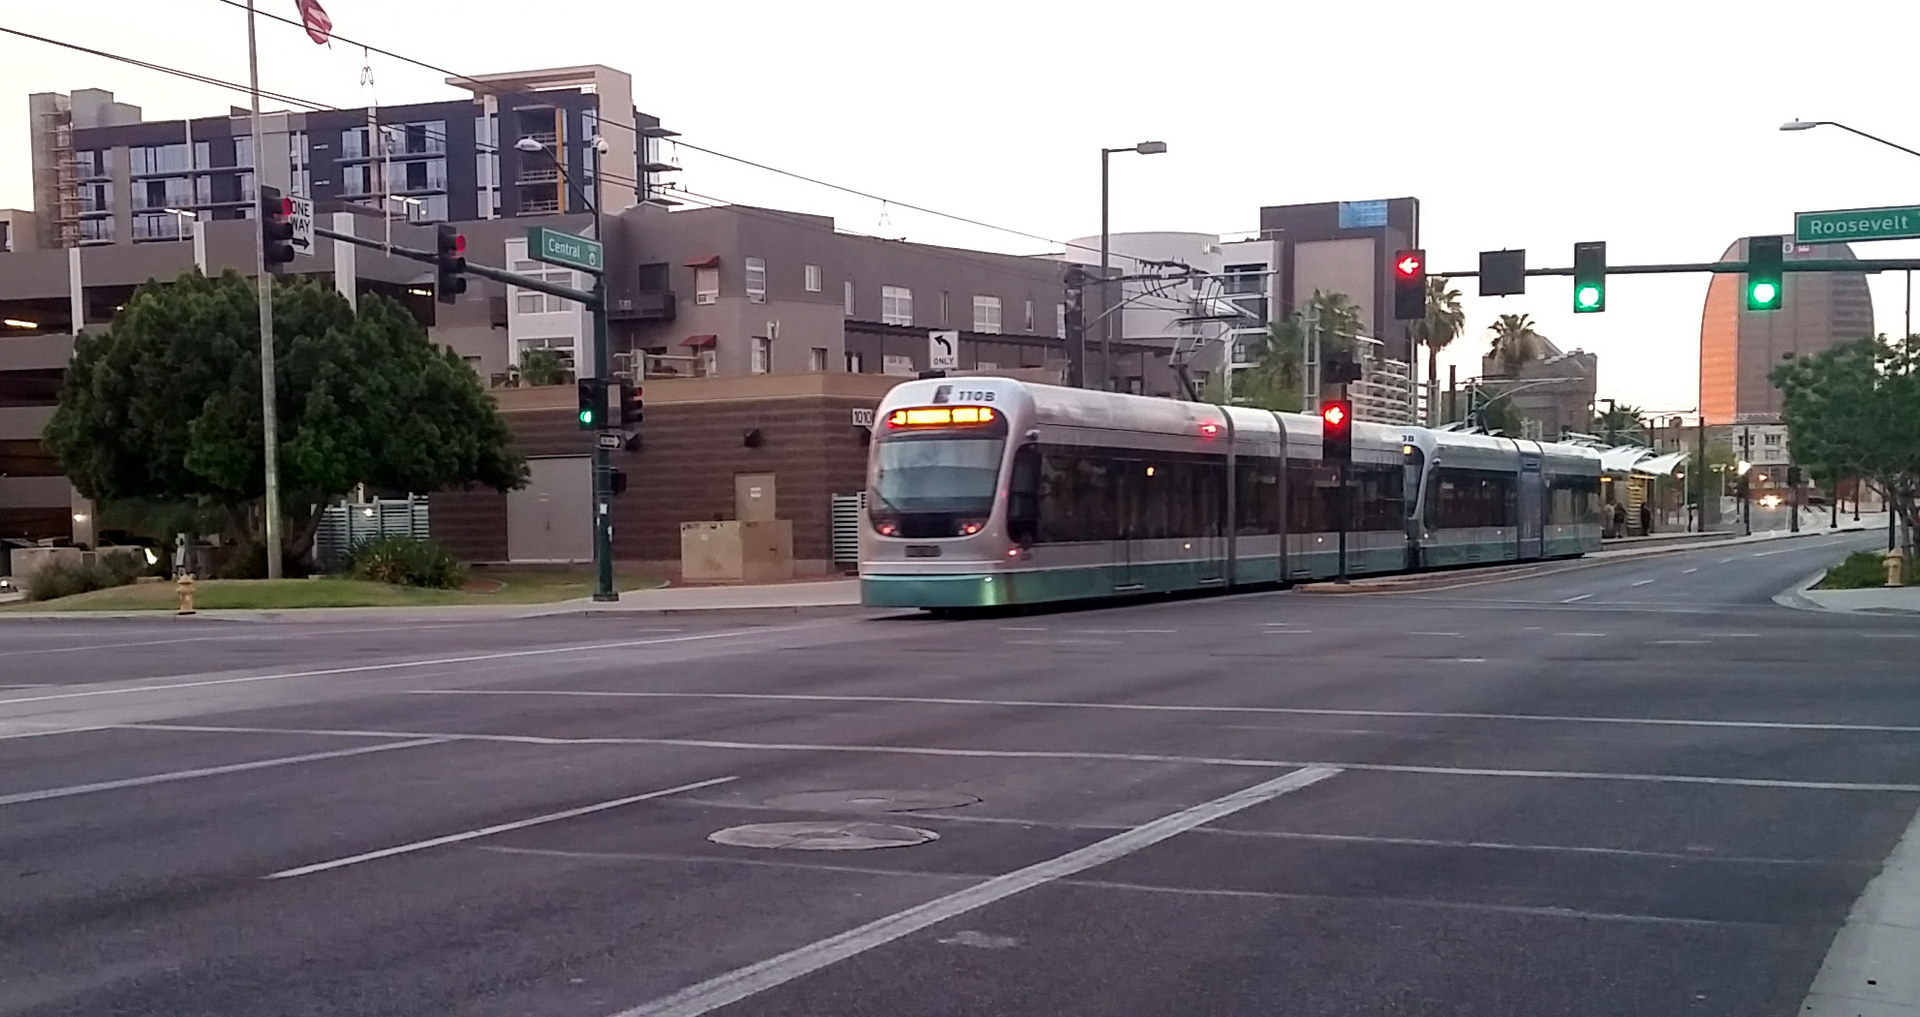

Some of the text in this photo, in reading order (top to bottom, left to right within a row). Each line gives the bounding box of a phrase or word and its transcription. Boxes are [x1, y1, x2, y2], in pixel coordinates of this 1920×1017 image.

[291, 200, 310, 217] ONE
[290, 216, 311, 234] WAY
[1811, 215, 1908, 235] Roosevelt
[548, 238, 580, 258] Central
[933, 357, 954, 366] ONLY
[958, 391, 996, 402] 110B
[854, 411, 872, 424] 1010
